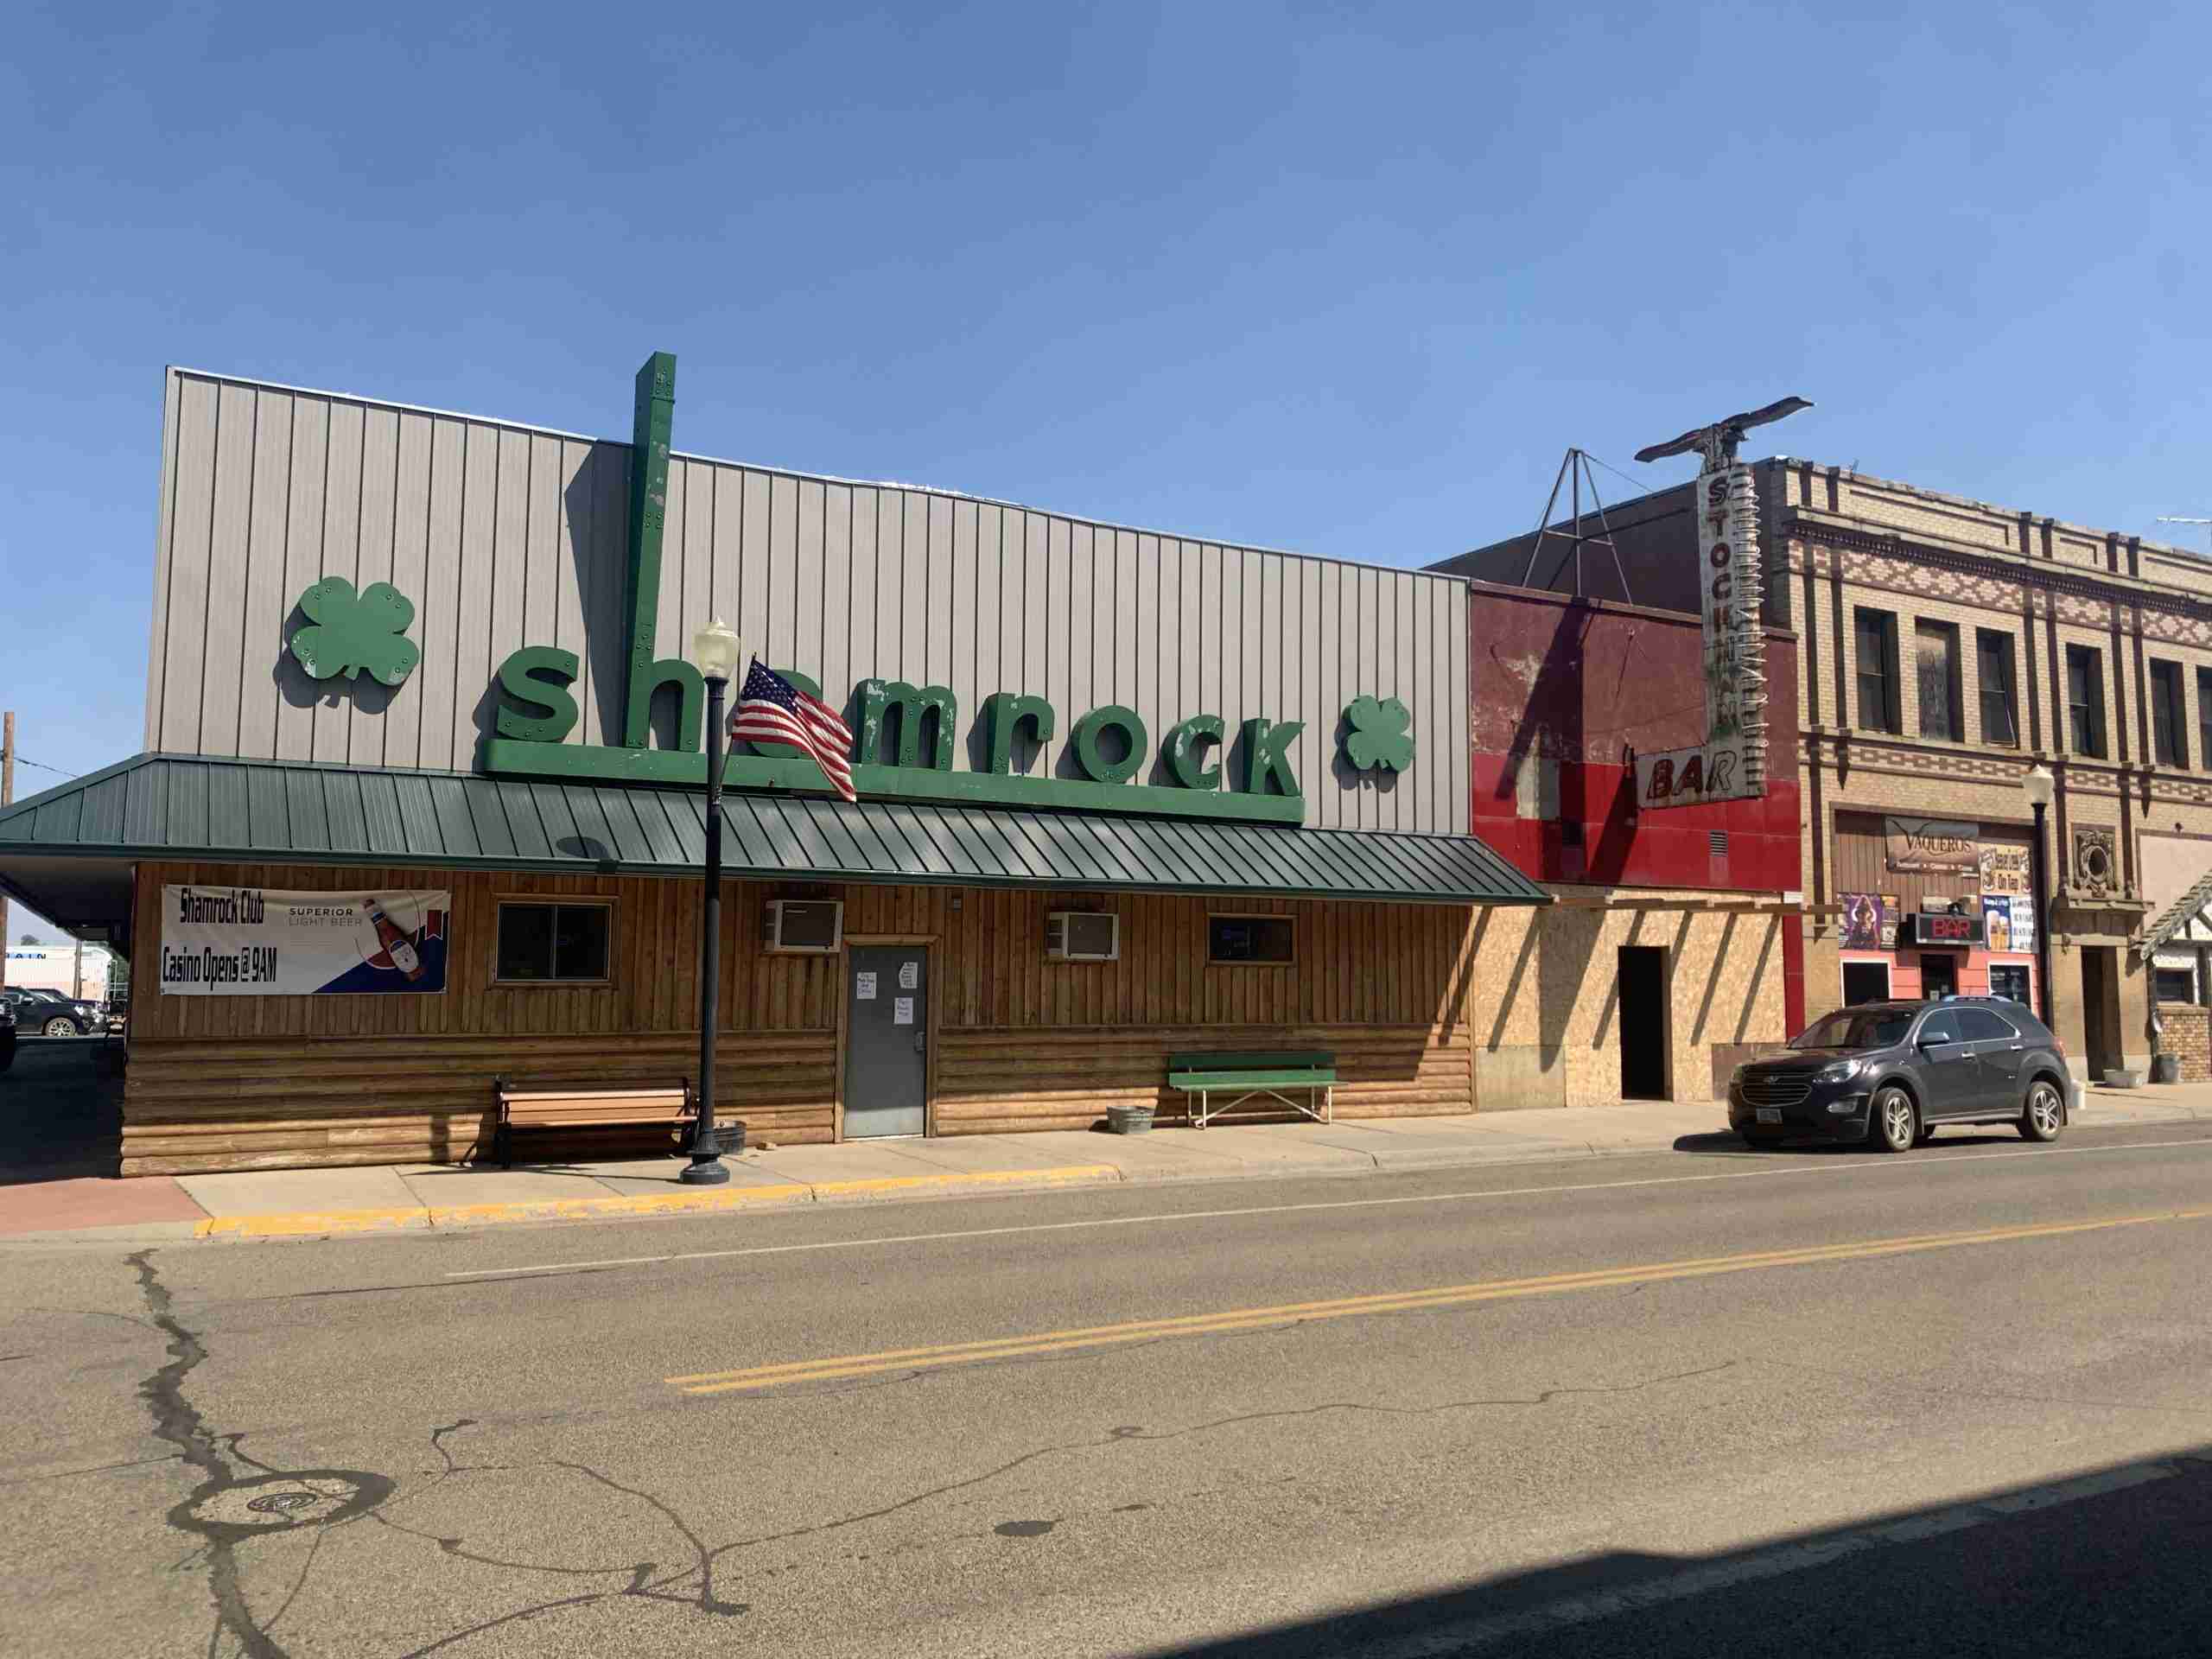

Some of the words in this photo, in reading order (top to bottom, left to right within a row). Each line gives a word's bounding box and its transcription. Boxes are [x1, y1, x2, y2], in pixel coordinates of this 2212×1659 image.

[1647, 749, 1737, 799] BAR
[180, 887, 238, 924] Shamrock
[241, 890, 264, 924] Club
[289, 907, 353, 916] SUPERIOR
[289, 918, 325, 926] LIGHT
[331, 918, 362, 926] BEER
[1931, 918, 1971, 938] BAR
[162, 947, 201, 982] Casino
[202, 947, 239, 991] Opens
[241, 947, 251, 982] @
[251, 947, 277, 982] 9AM
